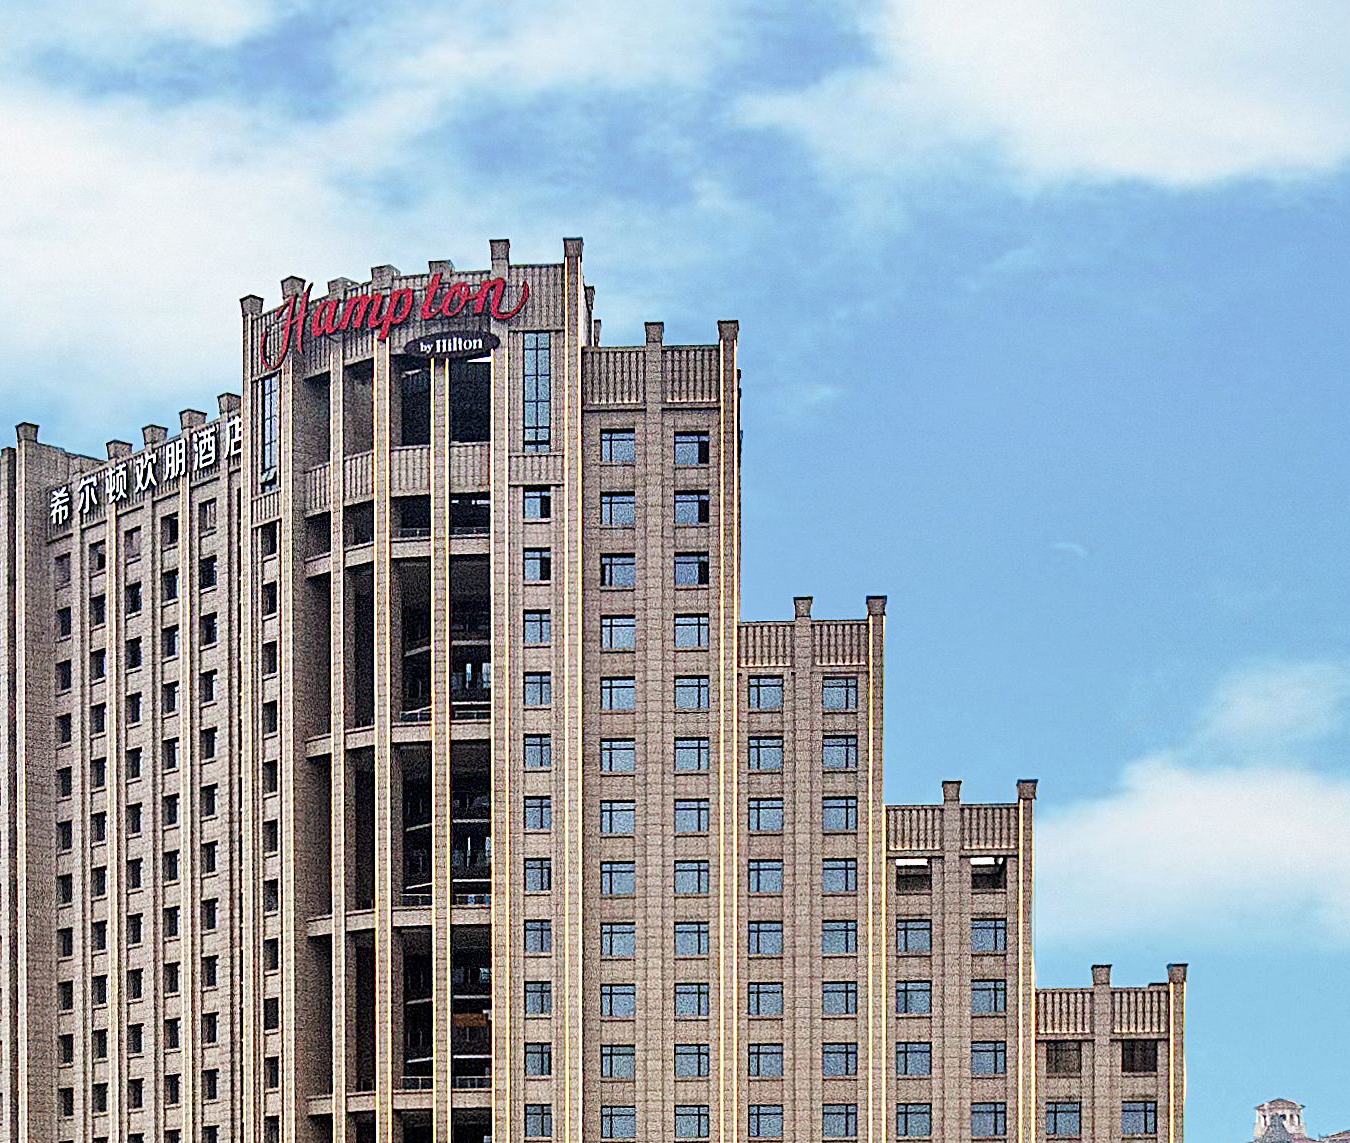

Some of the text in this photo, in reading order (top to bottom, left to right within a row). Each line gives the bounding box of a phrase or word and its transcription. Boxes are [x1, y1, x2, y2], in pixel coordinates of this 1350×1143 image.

[260, 273, 529, 370] Hampton
[419, 337, 483, 353] by Hilton
[50, 416, 243, 525] 希尔顿欢朋酒店
